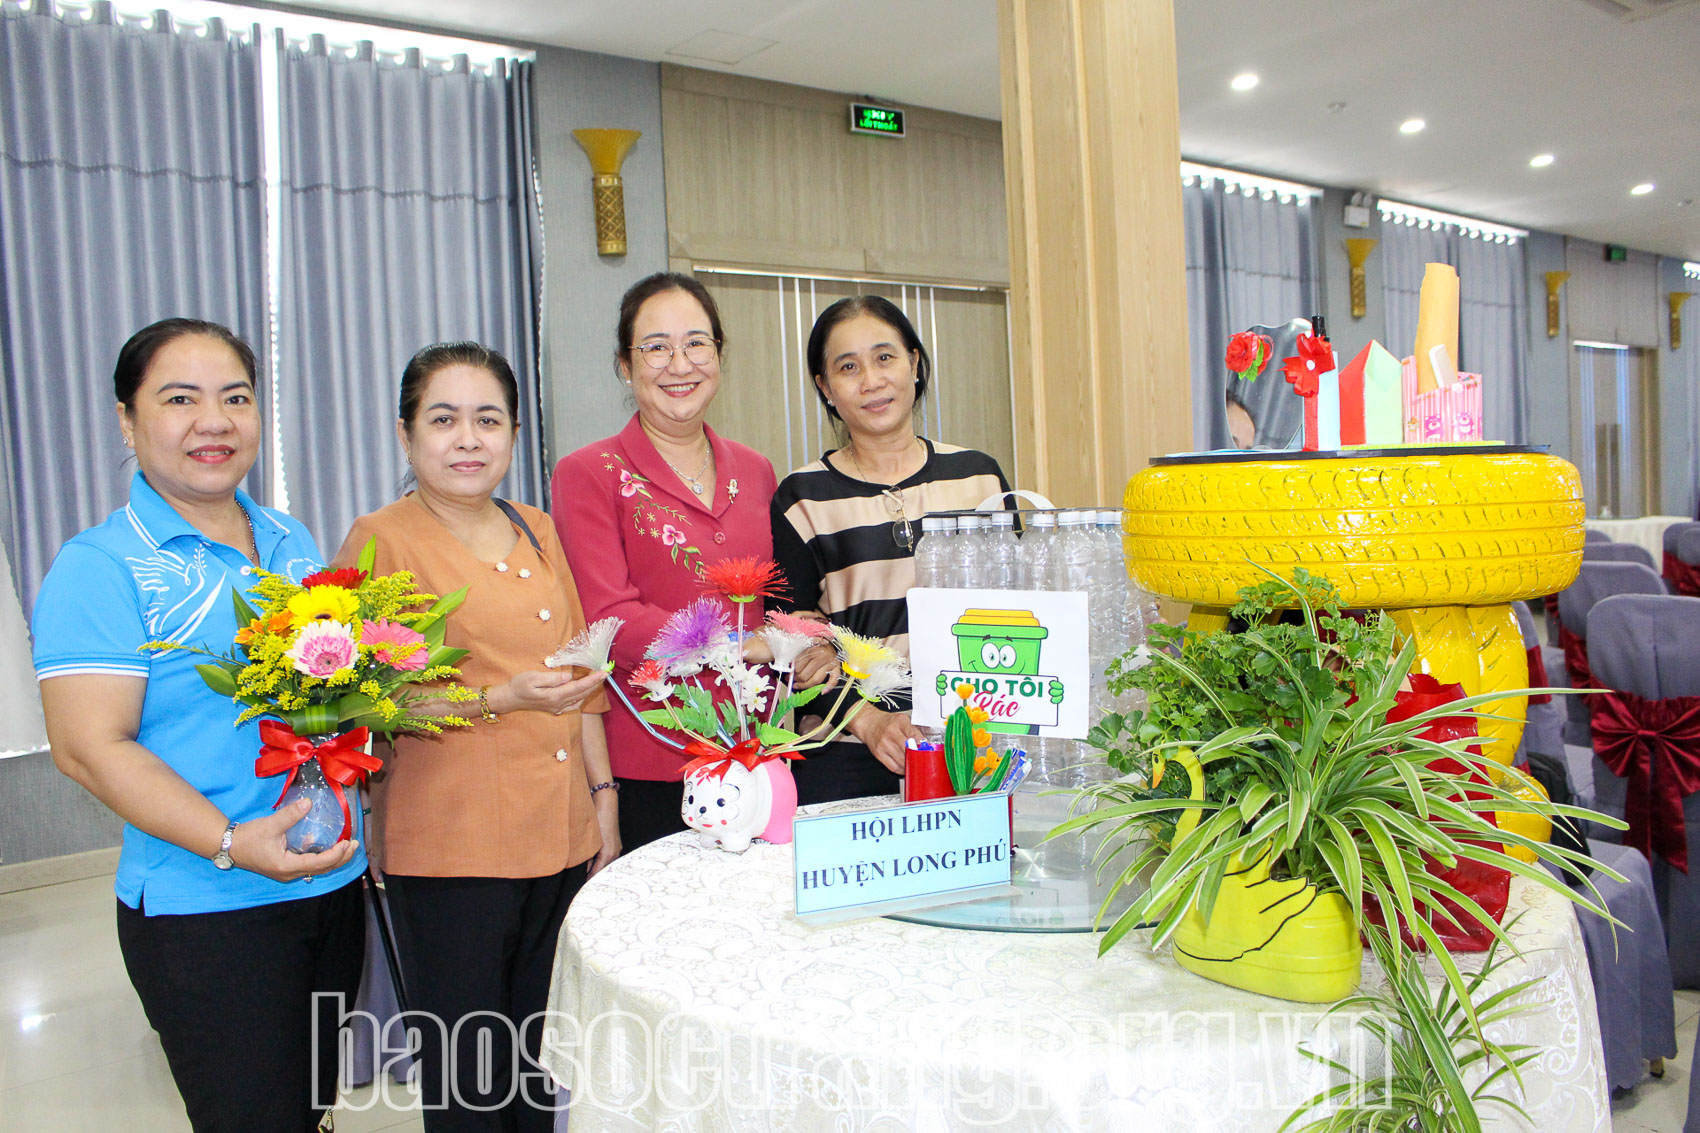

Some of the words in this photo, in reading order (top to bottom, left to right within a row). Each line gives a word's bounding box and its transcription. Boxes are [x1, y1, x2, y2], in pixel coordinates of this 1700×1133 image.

[950, 676, 999, 695] CHO
[1005, 676, 1043, 698] TÔI
[851, 816, 894, 843] HỘI
[902, 809, 962, 834] LHPN
[802, 860, 885, 887] HUYỆN
[893, 851, 957, 877] LONG
[964, 838, 1007, 866] PHÚ
